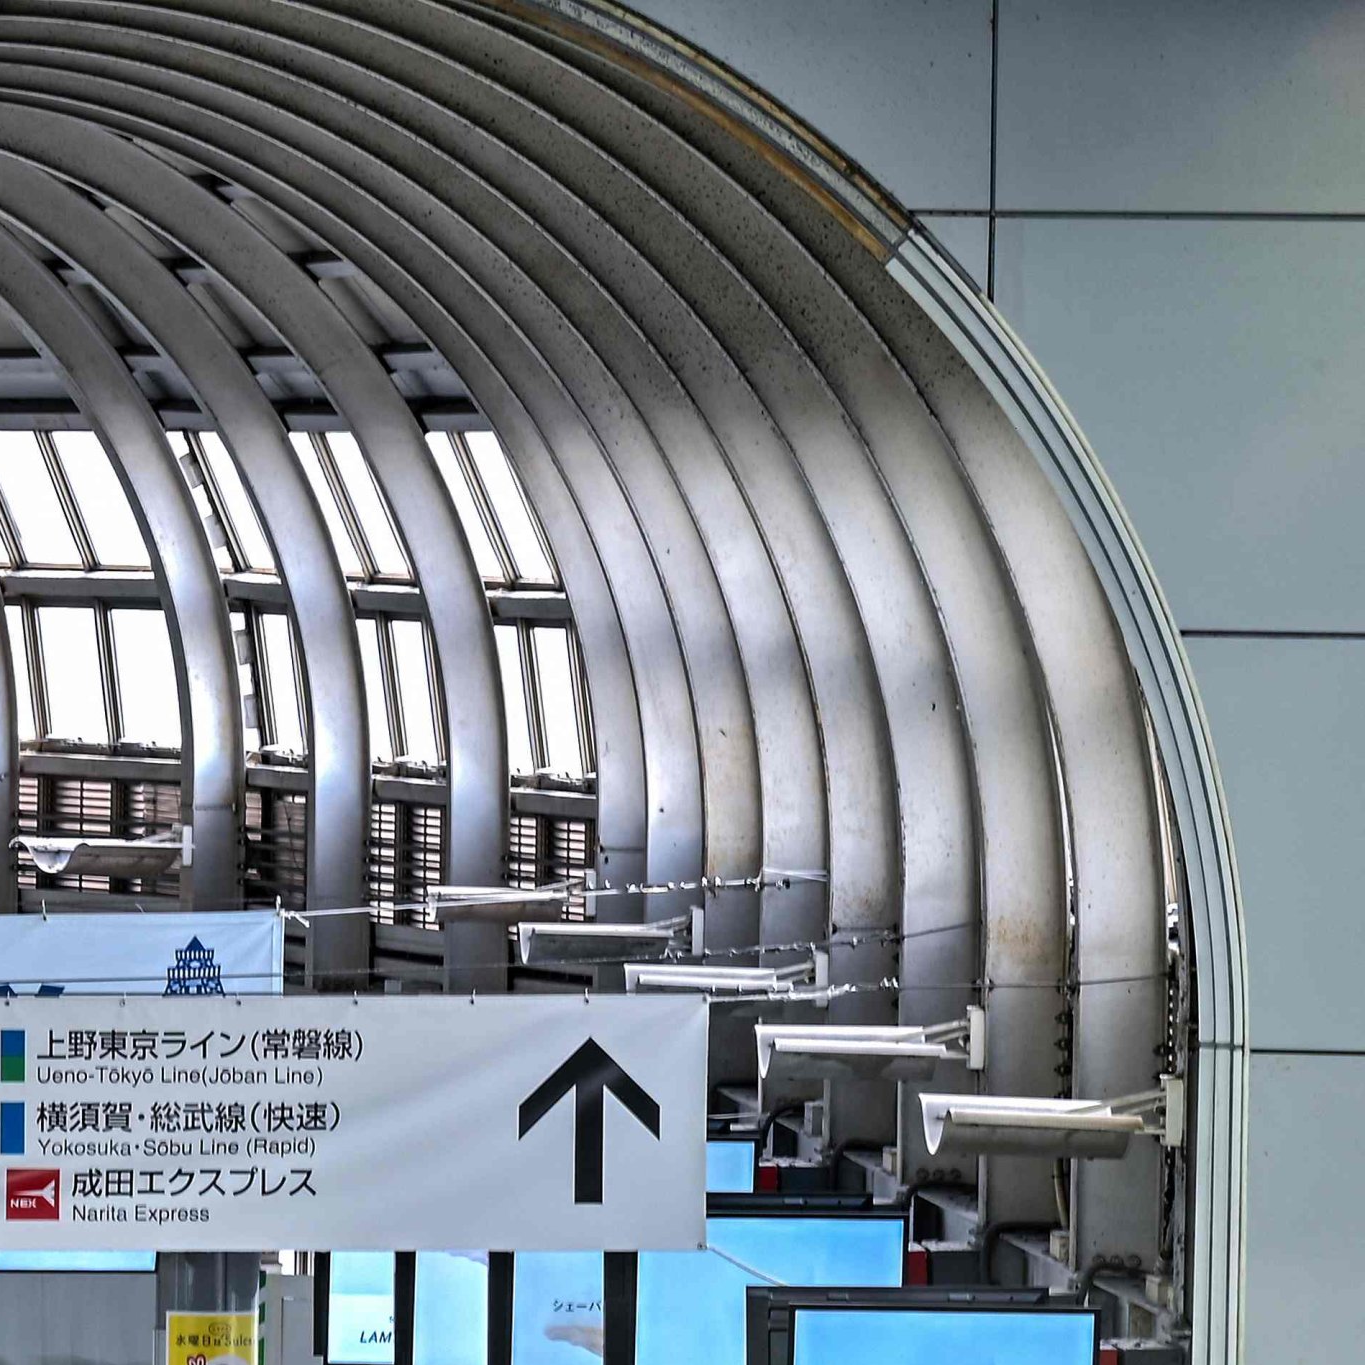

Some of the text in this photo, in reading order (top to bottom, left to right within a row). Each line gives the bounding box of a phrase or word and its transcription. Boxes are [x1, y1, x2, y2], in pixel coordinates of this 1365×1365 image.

[37, 1029, 364, 1063] 上野東京ライン(常磐線)
[37, 1066, 153, 1085] Ueno-Tōkyō
[274, 1067, 323, 1087] Line)
[36, 1102, 343, 1135] 横須賀・総武線(快速)
[199, 1139, 239, 1157] Line
[245, 1138, 316, 1158] (Rapid)
[72, 1169, 316, 1199] 成田エクスプレス
[72, 1204, 210, 1225] Narita Express
